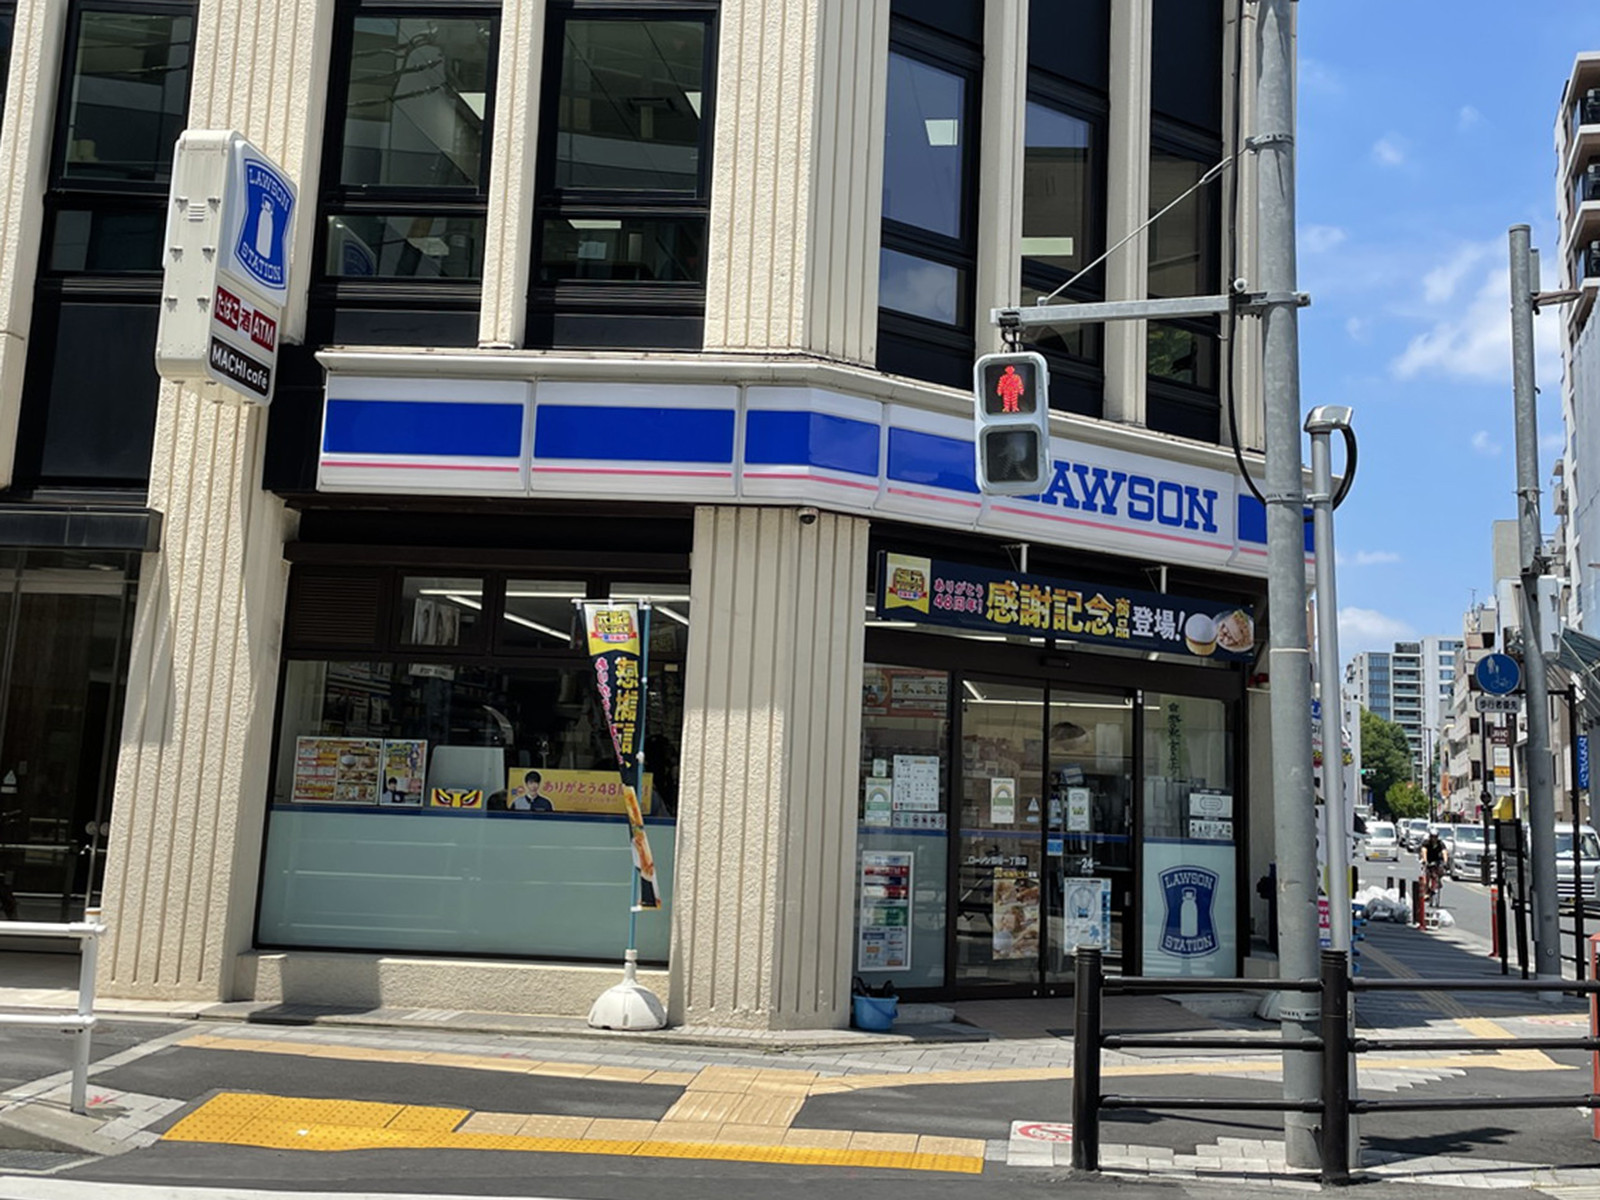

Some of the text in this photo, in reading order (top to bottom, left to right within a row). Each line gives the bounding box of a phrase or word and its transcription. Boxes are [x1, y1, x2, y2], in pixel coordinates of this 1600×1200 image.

[248, 168, 289, 212] LAWSON
[240, 242, 281, 281] STATION
[217, 291, 275, 349] たばこ 酒 ATM
[213, 344, 269, 391] MACHI café
[1012, 460, 1218, 533] AWSON
[933, 577, 985, 598] ありがとう
[986, 579, 1114, 637] 感謝記念
[1132, 605, 1186, 642] 登場!
[1164, 871, 1214, 890] LAWSON
[1164, 934, 1213, 955] STATION
